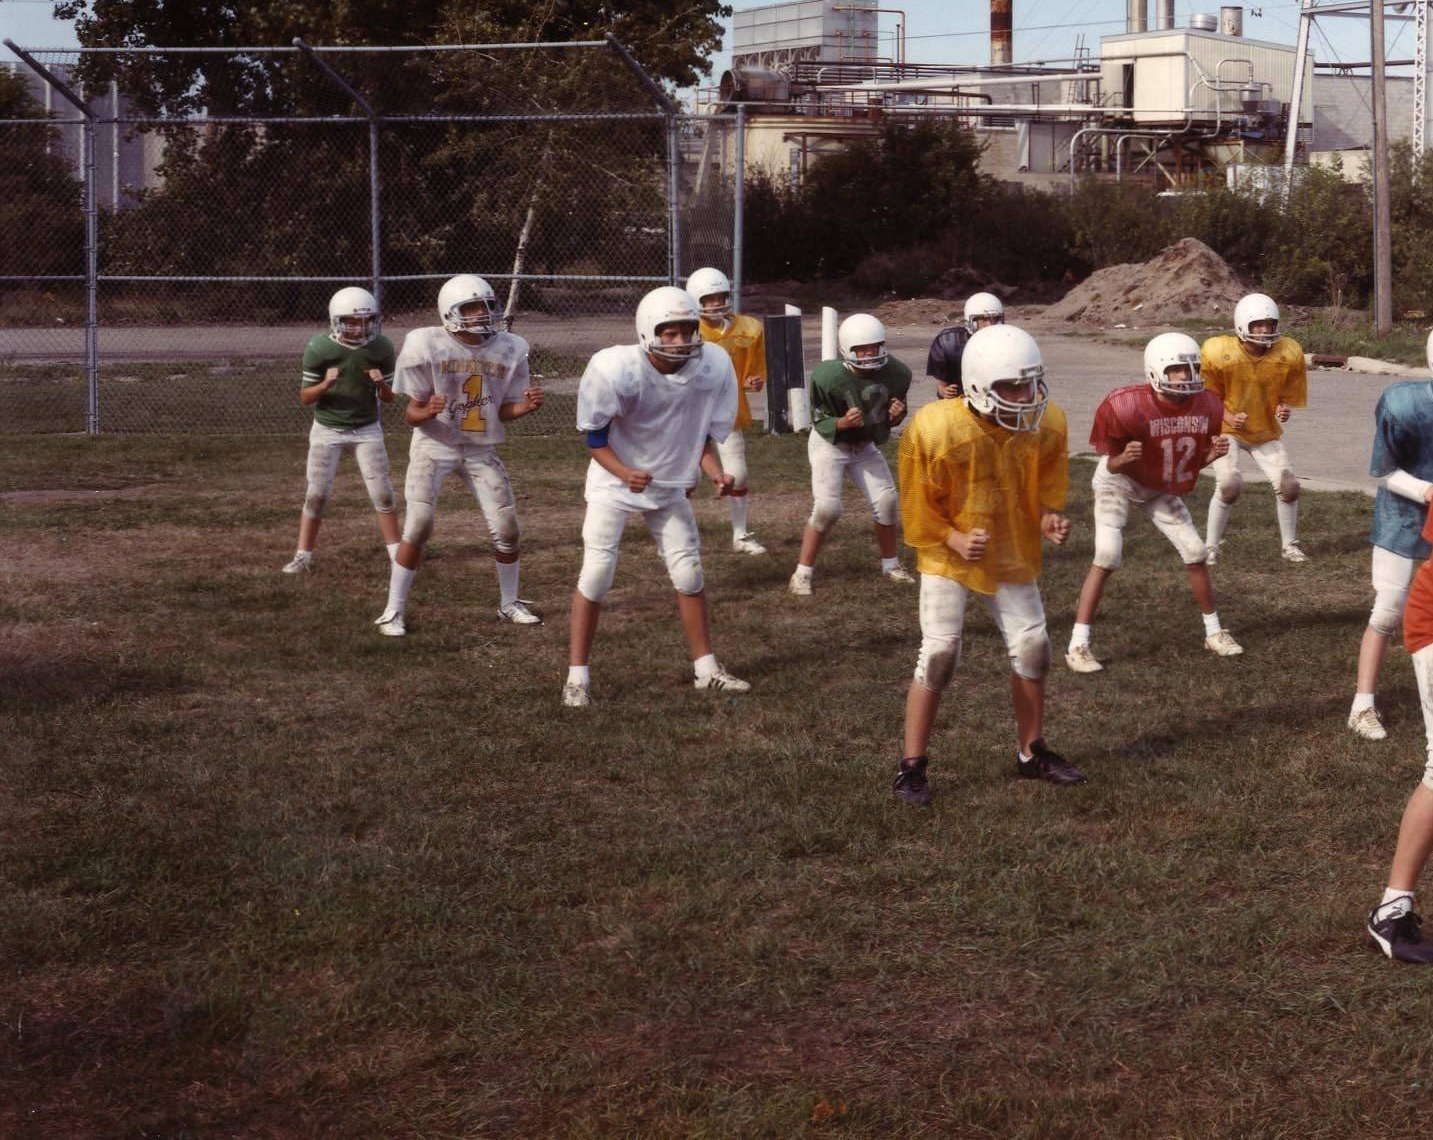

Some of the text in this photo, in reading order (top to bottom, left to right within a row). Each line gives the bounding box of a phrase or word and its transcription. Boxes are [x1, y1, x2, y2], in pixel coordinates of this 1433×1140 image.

[461, 374, 486, 432] 1
[1149, 415, 1209, 437] WISCONSIN
[1160, 436, 1197, 483] 12
